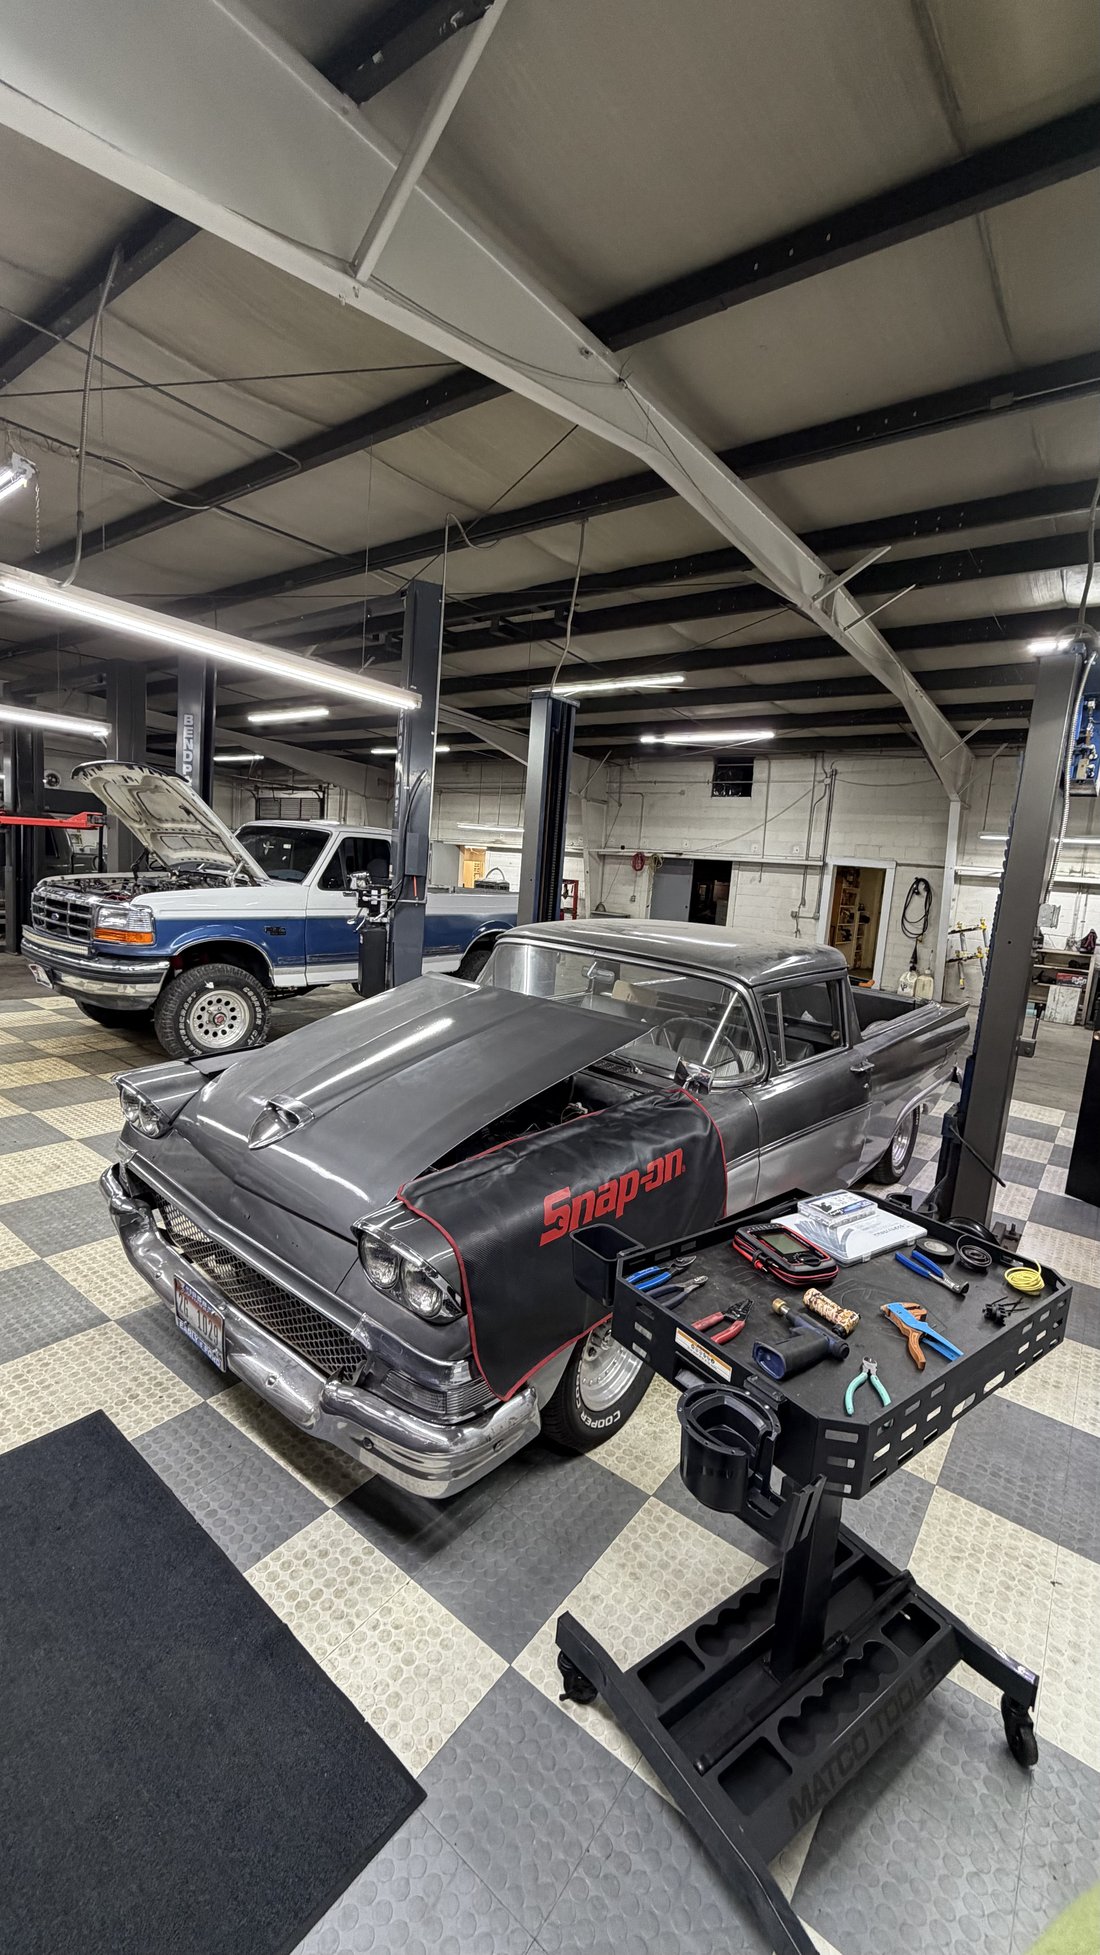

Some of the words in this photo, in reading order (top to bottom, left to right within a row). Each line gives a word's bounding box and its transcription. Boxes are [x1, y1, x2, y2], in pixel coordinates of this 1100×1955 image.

[539, 1148, 684, 1247] Snap-on
[197, 1309, 218, 1347] 1029
[580, 1410, 621, 1429] COOPER
[787, 1729, 869, 1829] MATCO
[870, 1659, 936, 1737] TOOLS
